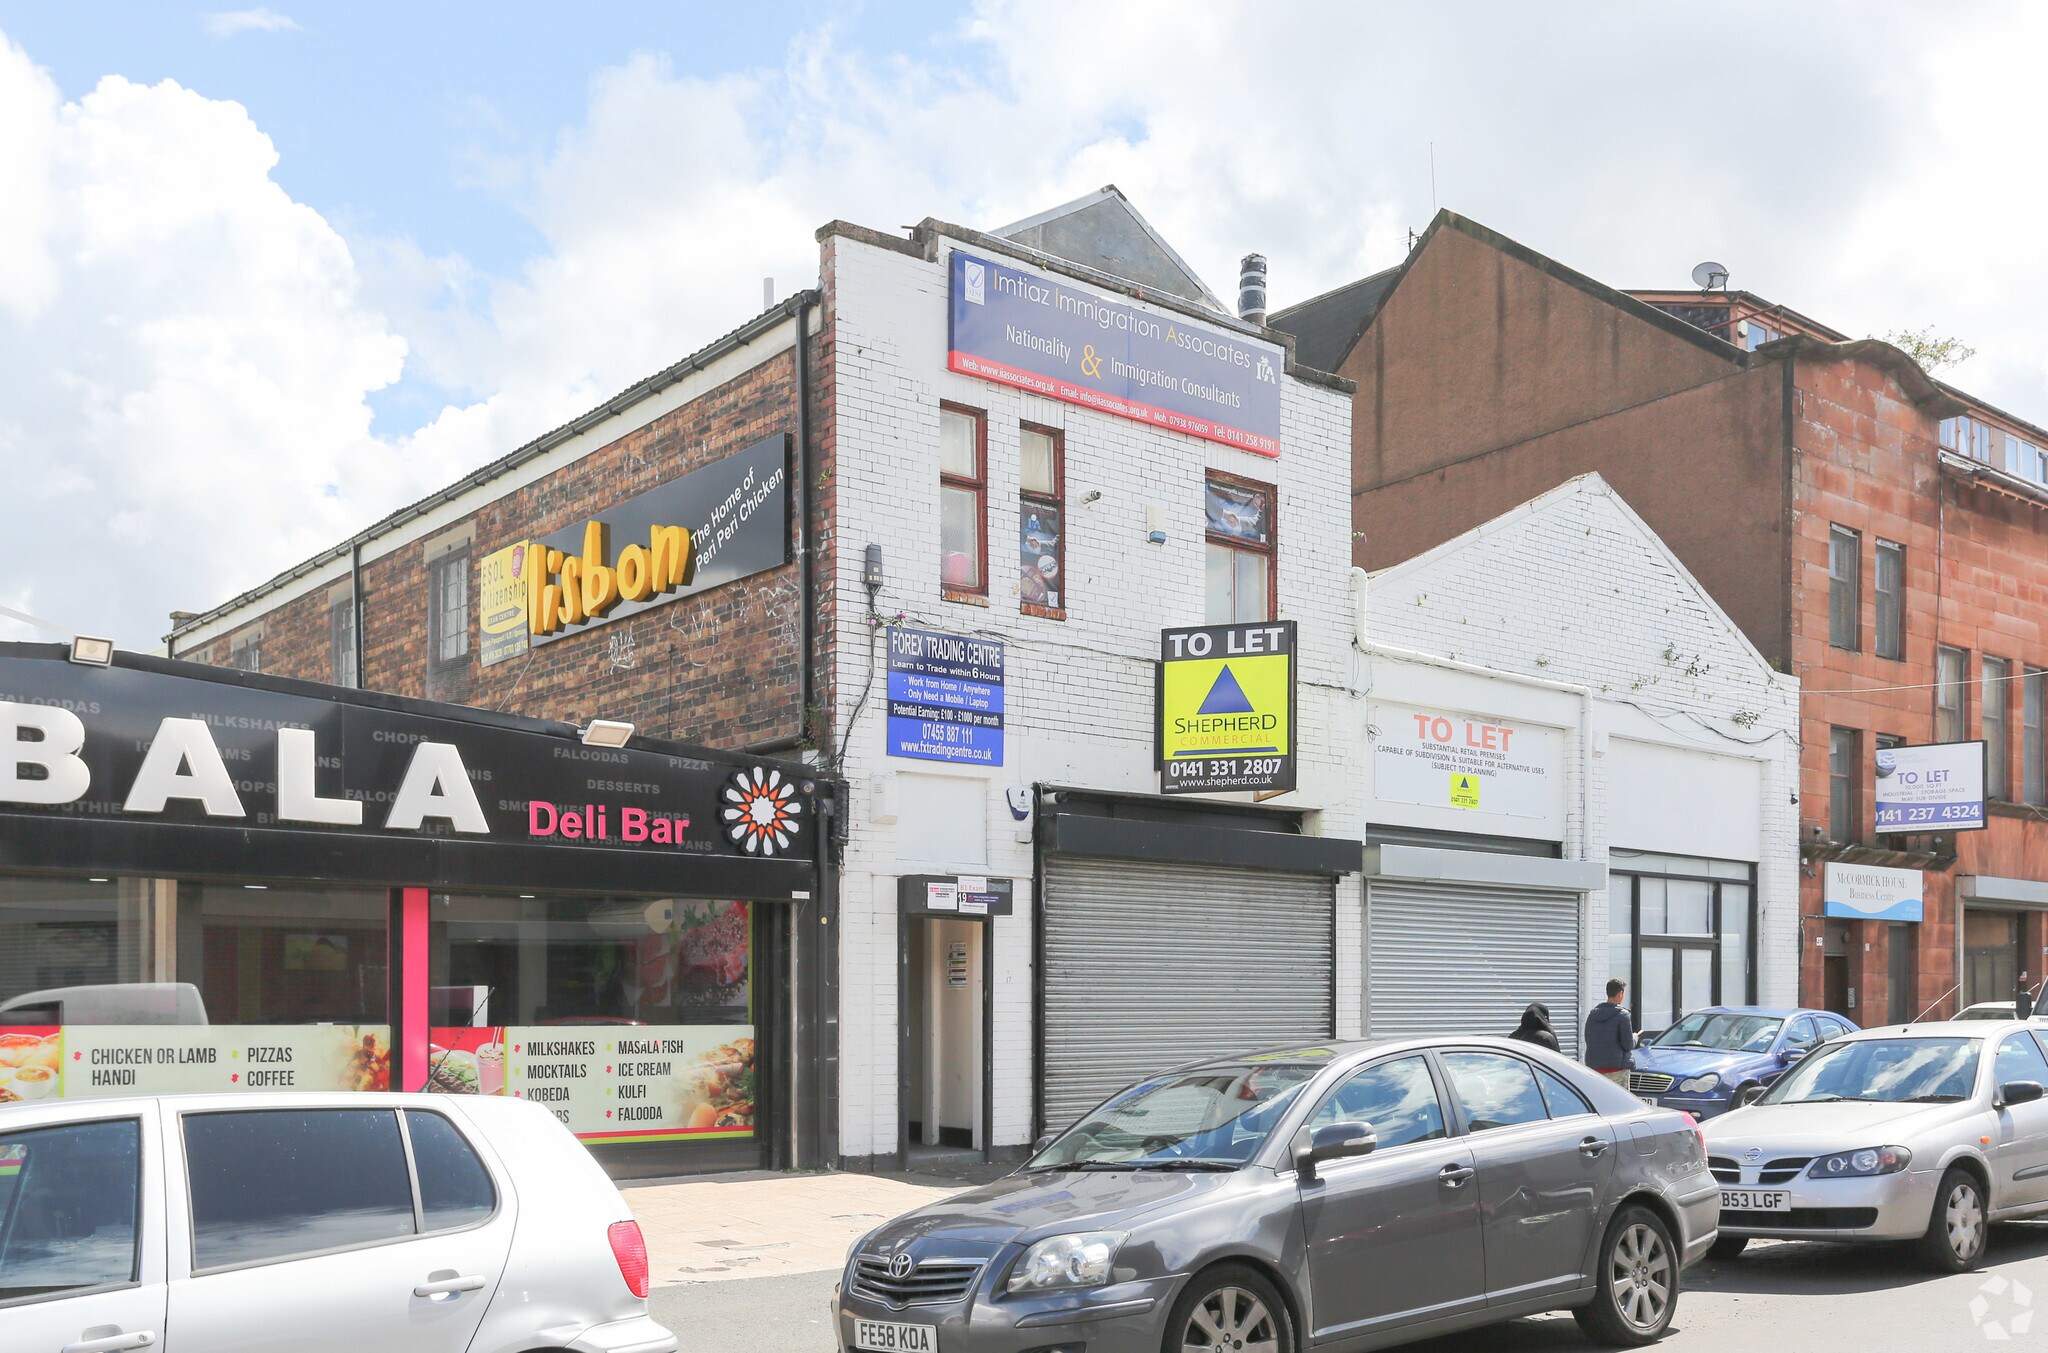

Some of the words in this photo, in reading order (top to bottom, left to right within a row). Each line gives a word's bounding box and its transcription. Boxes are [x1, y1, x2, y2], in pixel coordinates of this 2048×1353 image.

[994, 269, 1050, 306] Imtiaz
[1055, 287, 1160, 340] Immigration
[1165, 325, 1251, 368] Associates
[1006, 324, 1071, 364] Nationality
[1080, 344, 1103, 380] &
[1111, 357, 1178, 391] Immigration
[1181, 377, 1241, 409] Consultants
[962, 357, 979, 372] Web:
[1060, 385, 1079, 400] Email:
[1169, 415, 1187, 429] 07938
[1188, 420, 1209, 434] 976059
[1213, 425, 1226, 439] Tel:
[1227, 428, 1244, 443] 0141
[1245, 433, 1258, 447] 258
[1259, 436, 1275, 451] 9191
[690, 523, 711, 550] The
[710, 487, 742, 528] Home
[743, 466, 755, 491] of
[695, 539, 717, 573] Peri
[716, 513, 739, 549] Peri
[740, 467, 784, 521] Chicken
[482, 558, 504, 587] ESOL
[528, 520, 694, 638] lisbon
[481, 576, 526, 612] Citizenship
[892, 631, 923, 657] FOREX
[926, 637, 965, 663] TRADING
[967, 642, 1001, 668] CENTRE
[1169, 632, 1212, 658] TO
[1227, 627, 1284, 654] LET
[892, 659, 914, 670] Learn
[916, 663, 925, 671] to
[926, 664, 947, 674] Trade
[949, 667, 971, 677] within
[972, 668, 979, 679] 6
[979, 671, 1001, 682] Hours
[907, 676, 924, 687] Work
[925, 678, 940, 689] from
[940, 680, 958, 691] Home
[963, 684, 991, 696] Anywhere
[907, 689, 922, 701] Only
[923, 691, 939, 701] Need
[945, 693, 964, 705] Mobile
[969, 696, 989, 710] Laptop
[893, 703, 917, 716] Potential
[973, 715, 983, 726] per
[983, 716, 999, 726] month
[1174, 714, 1277, 734] SHEPHERD
[922, 722, 945, 741] 07455
[946, 725, 960, 743] 887
[961, 728, 973, 745] 111
[1180, 733, 1271, 747] COMMERCIAL
[1413, 714, 1453, 743] TO
[1466, 722, 1514, 752] LET
[553, 746, 629, 765] FALOODAS
[900, 740, 992, 761] www.fxtradingcentre.co.uk
[1377, 744, 1403, 755] CAPABLE
[1405, 748, 1413, 756] OF
[1415, 750, 1450, 762] SUBDIVISION
[1458, 756, 1483, 767] SUITABLE
[1484, 760, 1496, 768] FOR
[1497, 762, 1530, 773] ALTERNATIVE
[1531, 767, 1545, 775] USES
[1422, 742, 1459, 754] SUBSTANTIAL
[1460, 748, 1478, 757] RETAIL
[1480, 750, 1506, 761] PREMISES
[1170, 761, 1204, 778] 0141
[1210, 760, 1237, 776] 331
[1243, 758, 1282, 775] 2807
[1458, 765, 1466, 773] TO
[1897, 772, 1918, 785] TO
[1926, 770, 1950, 783] LET
[587, 779, 660, 795] DESSERTS
[1179, 775, 1273, 788] www.shepherd.co.uk
[528, 800, 607, 840] Deli
[621, 807, 690, 844] Bar
[1908, 807, 1935, 821] 237
[1941, 804, 1980, 819] 4324
[1849, 888, 1875, 900] Business
[1875, 890, 1896, 902] Centre
[91, 1048, 152, 1065] CHICKEN
[156, 1048, 175, 1064] OR
[178, 1048, 217, 1063] LAMB
[247, 1047, 293, 1063] PIZZAS
[527, 1041, 595, 1056] MILKSHAKES
[618, 1040, 660, 1055] MASALA
[662, 1040, 684, 1054] FISH
[92, 1069, 136, 1086] HANDI
[247, 1070, 295, 1086] COFFEE
[527, 1064, 587, 1079] MOCKTAILS
[618, 1062, 635, 1077] ICE
[636, 1061, 671, 1076] CREAM
[527, 1087, 570, 1102] KOBEDA
[618, 1084, 647, 1099] KULFI
[618, 1107, 663, 1121] FALOODA
[1753, 1193, 1783, 1208] LGF
[861, 1323, 895, 1347] FE58
